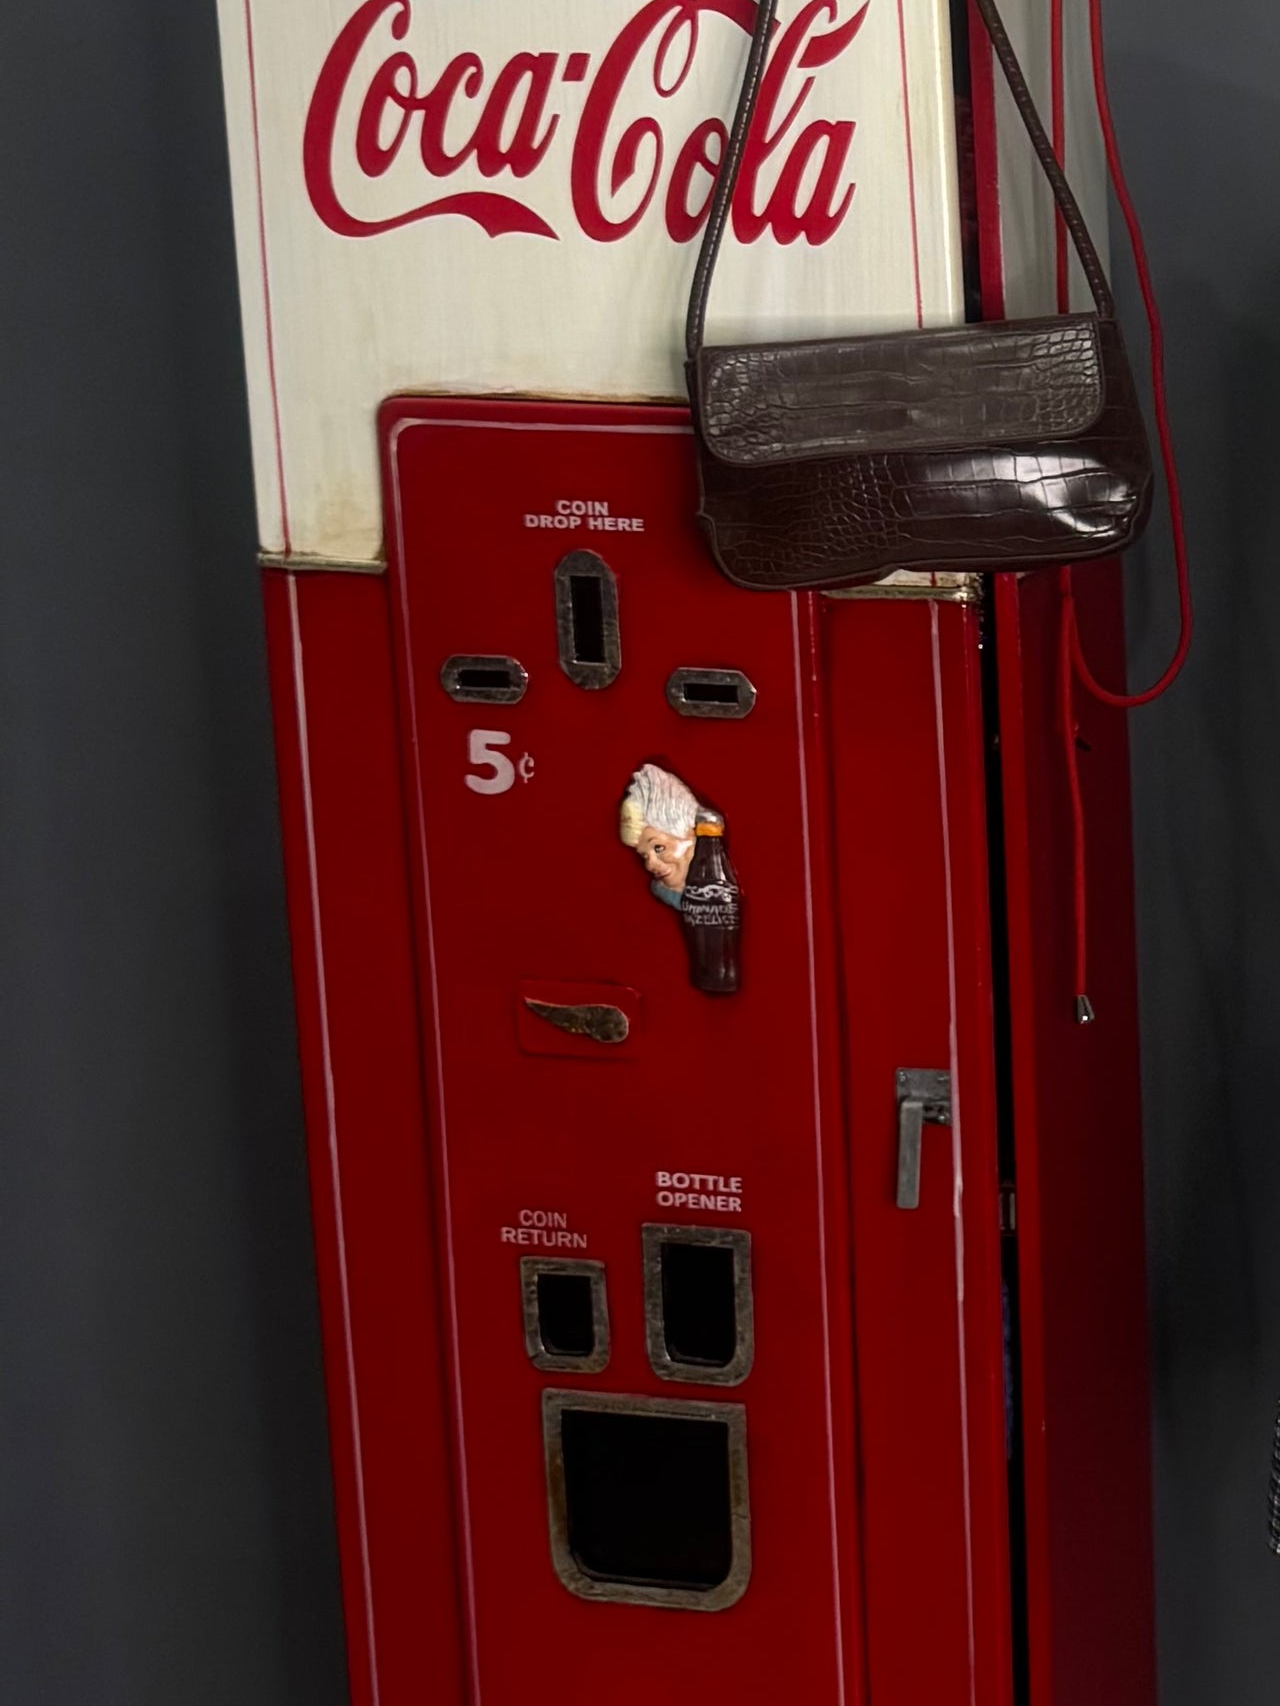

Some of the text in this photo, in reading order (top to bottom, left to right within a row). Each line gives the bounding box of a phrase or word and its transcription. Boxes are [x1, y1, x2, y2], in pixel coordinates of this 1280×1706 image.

[556, 500, 609, 516] COIN
[525, 513, 645, 532] DROP HERE
[656, 1171, 743, 1194] BOTTLE
[656, 1191, 743, 1212] OPENER
[518, 1209, 567, 1229] COIN
[501, 1226, 587, 1249] RETURN
